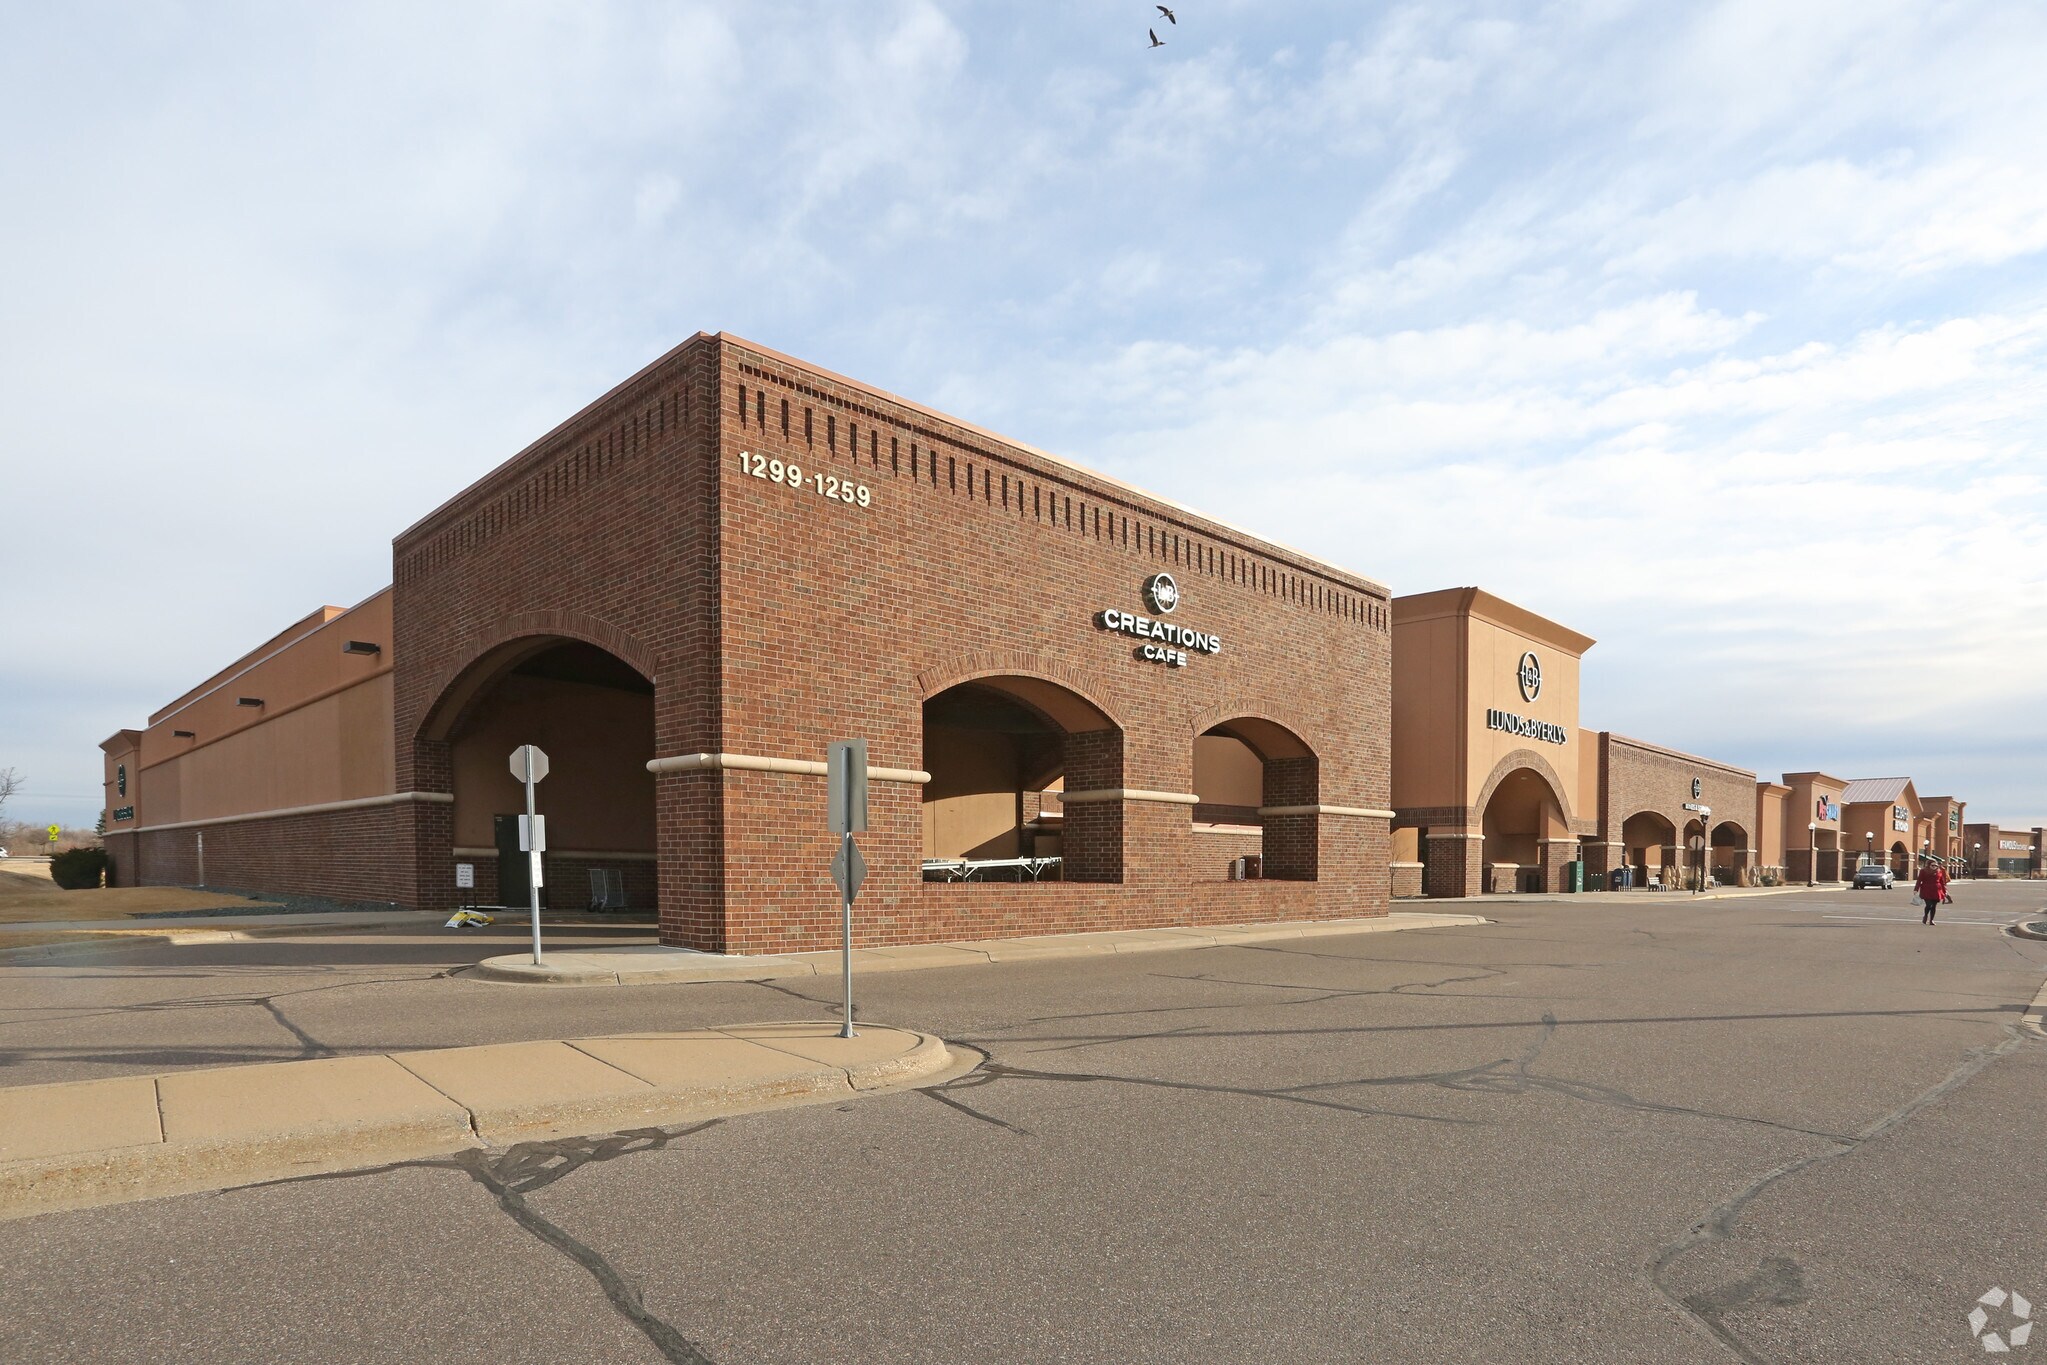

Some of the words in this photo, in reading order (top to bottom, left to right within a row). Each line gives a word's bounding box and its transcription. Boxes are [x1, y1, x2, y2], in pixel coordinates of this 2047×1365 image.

[739, 451, 871, 507] 1299-1259
[1104, 609, 1221, 654] CREATIONS
[1144, 645, 1187, 667] CAFE
